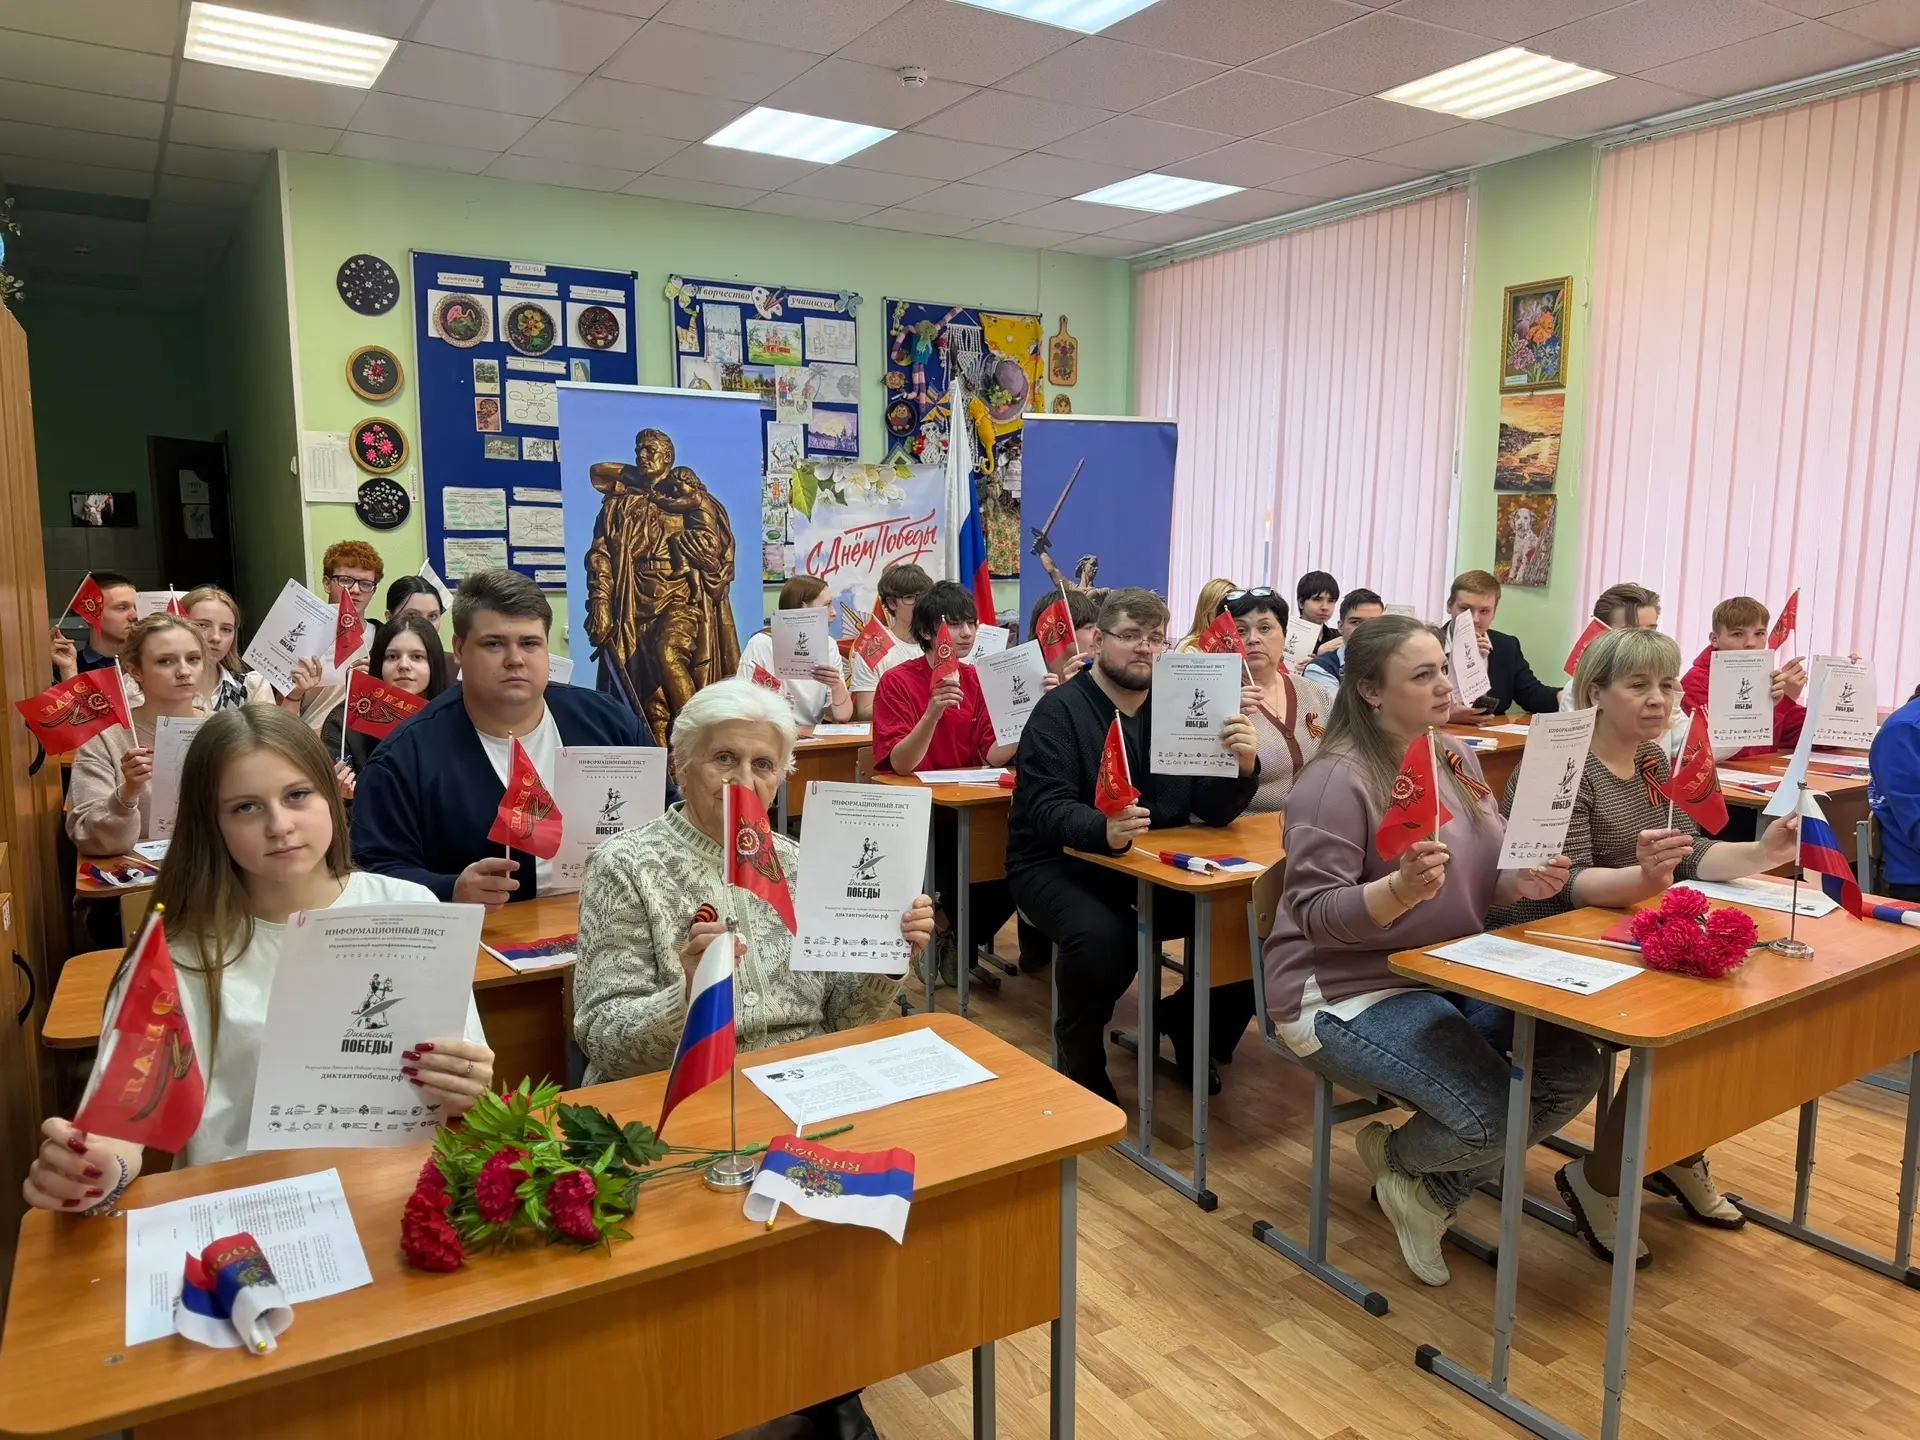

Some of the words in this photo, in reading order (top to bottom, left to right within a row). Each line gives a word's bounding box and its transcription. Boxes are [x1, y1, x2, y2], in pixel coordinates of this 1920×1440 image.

[790, 296, 834, 309] учащихся
[844, 508, 938, 573] Победы
[806, 541, 824, 576] С
[820, 532, 875, 580] Днём
[832, 800, 894, 809] ИНФОРМАЦИОННЫЙ
[846, 887, 881, 900] ПОБЕДЫ
[324, 926, 420, 937] ИНФОРМАЦИОННЫЙ
[421, 928, 446, 937] ЛИСТ
[343, 1028, 395, 1039] Диктант
[341, 1039, 394, 1056] ПОБЕДЫ
[320, 1072, 404, 1083] диктантпобеды.рф
